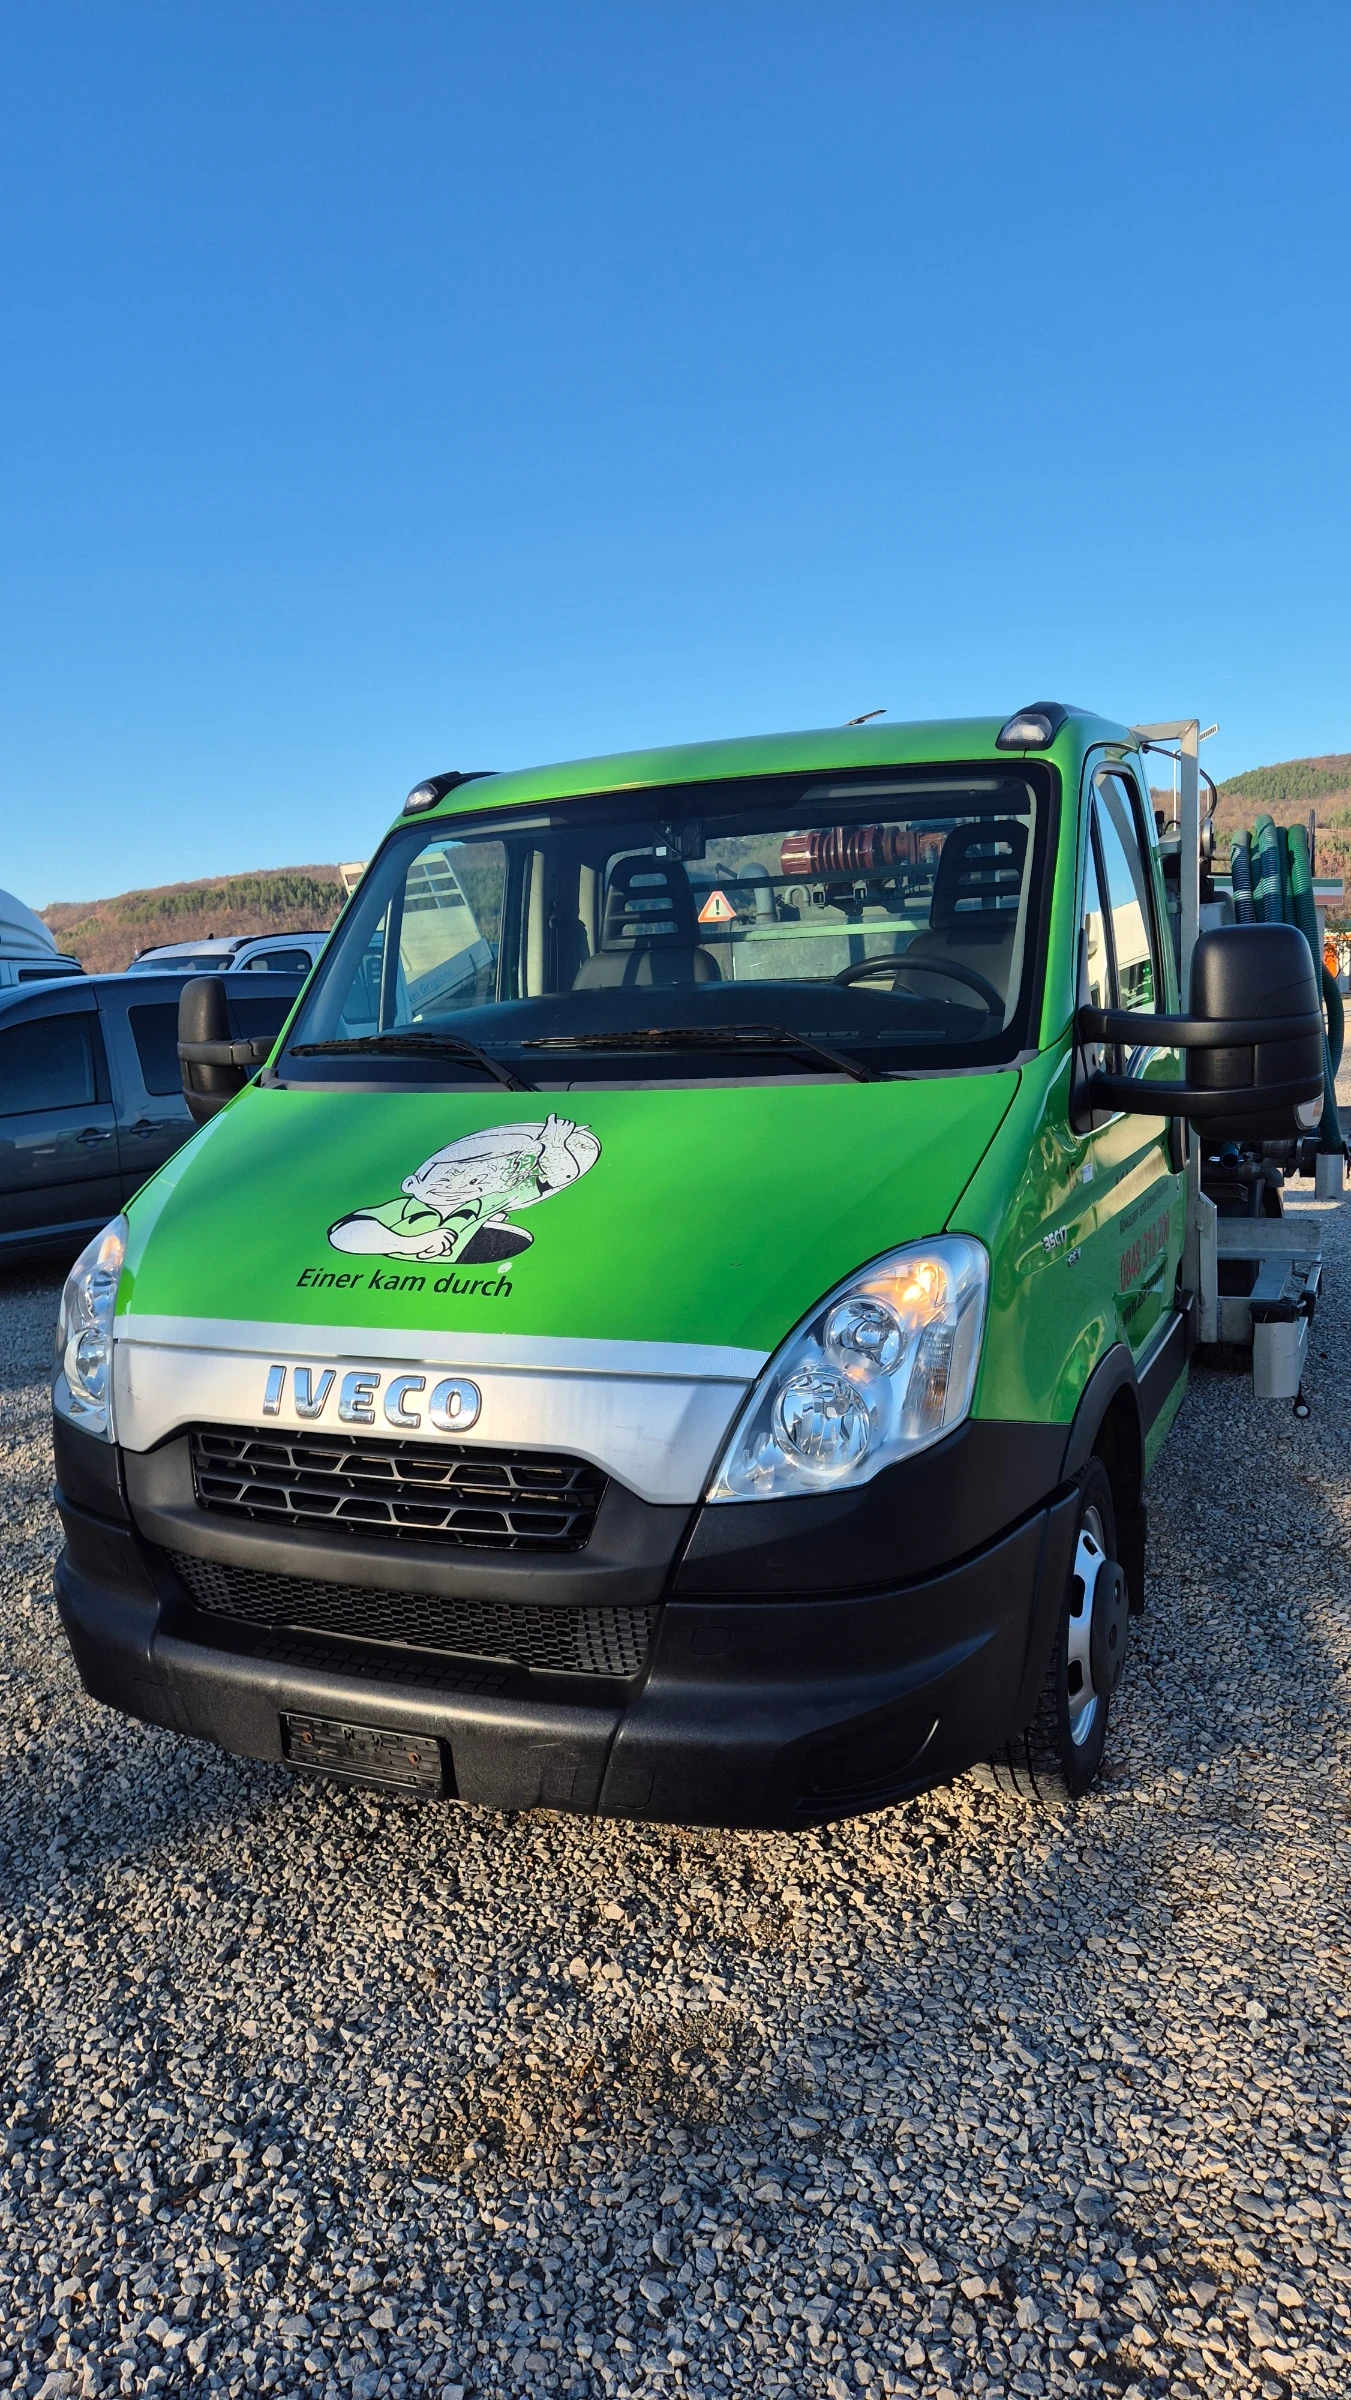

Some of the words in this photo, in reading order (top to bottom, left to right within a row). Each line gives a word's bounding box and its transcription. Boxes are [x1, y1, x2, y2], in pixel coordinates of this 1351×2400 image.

[296, 1268, 364, 1289] Einer
[367, 1269, 426, 1292] kam
[433, 1272, 513, 1298] durch
[262, 1365, 483, 1433] IVECO
